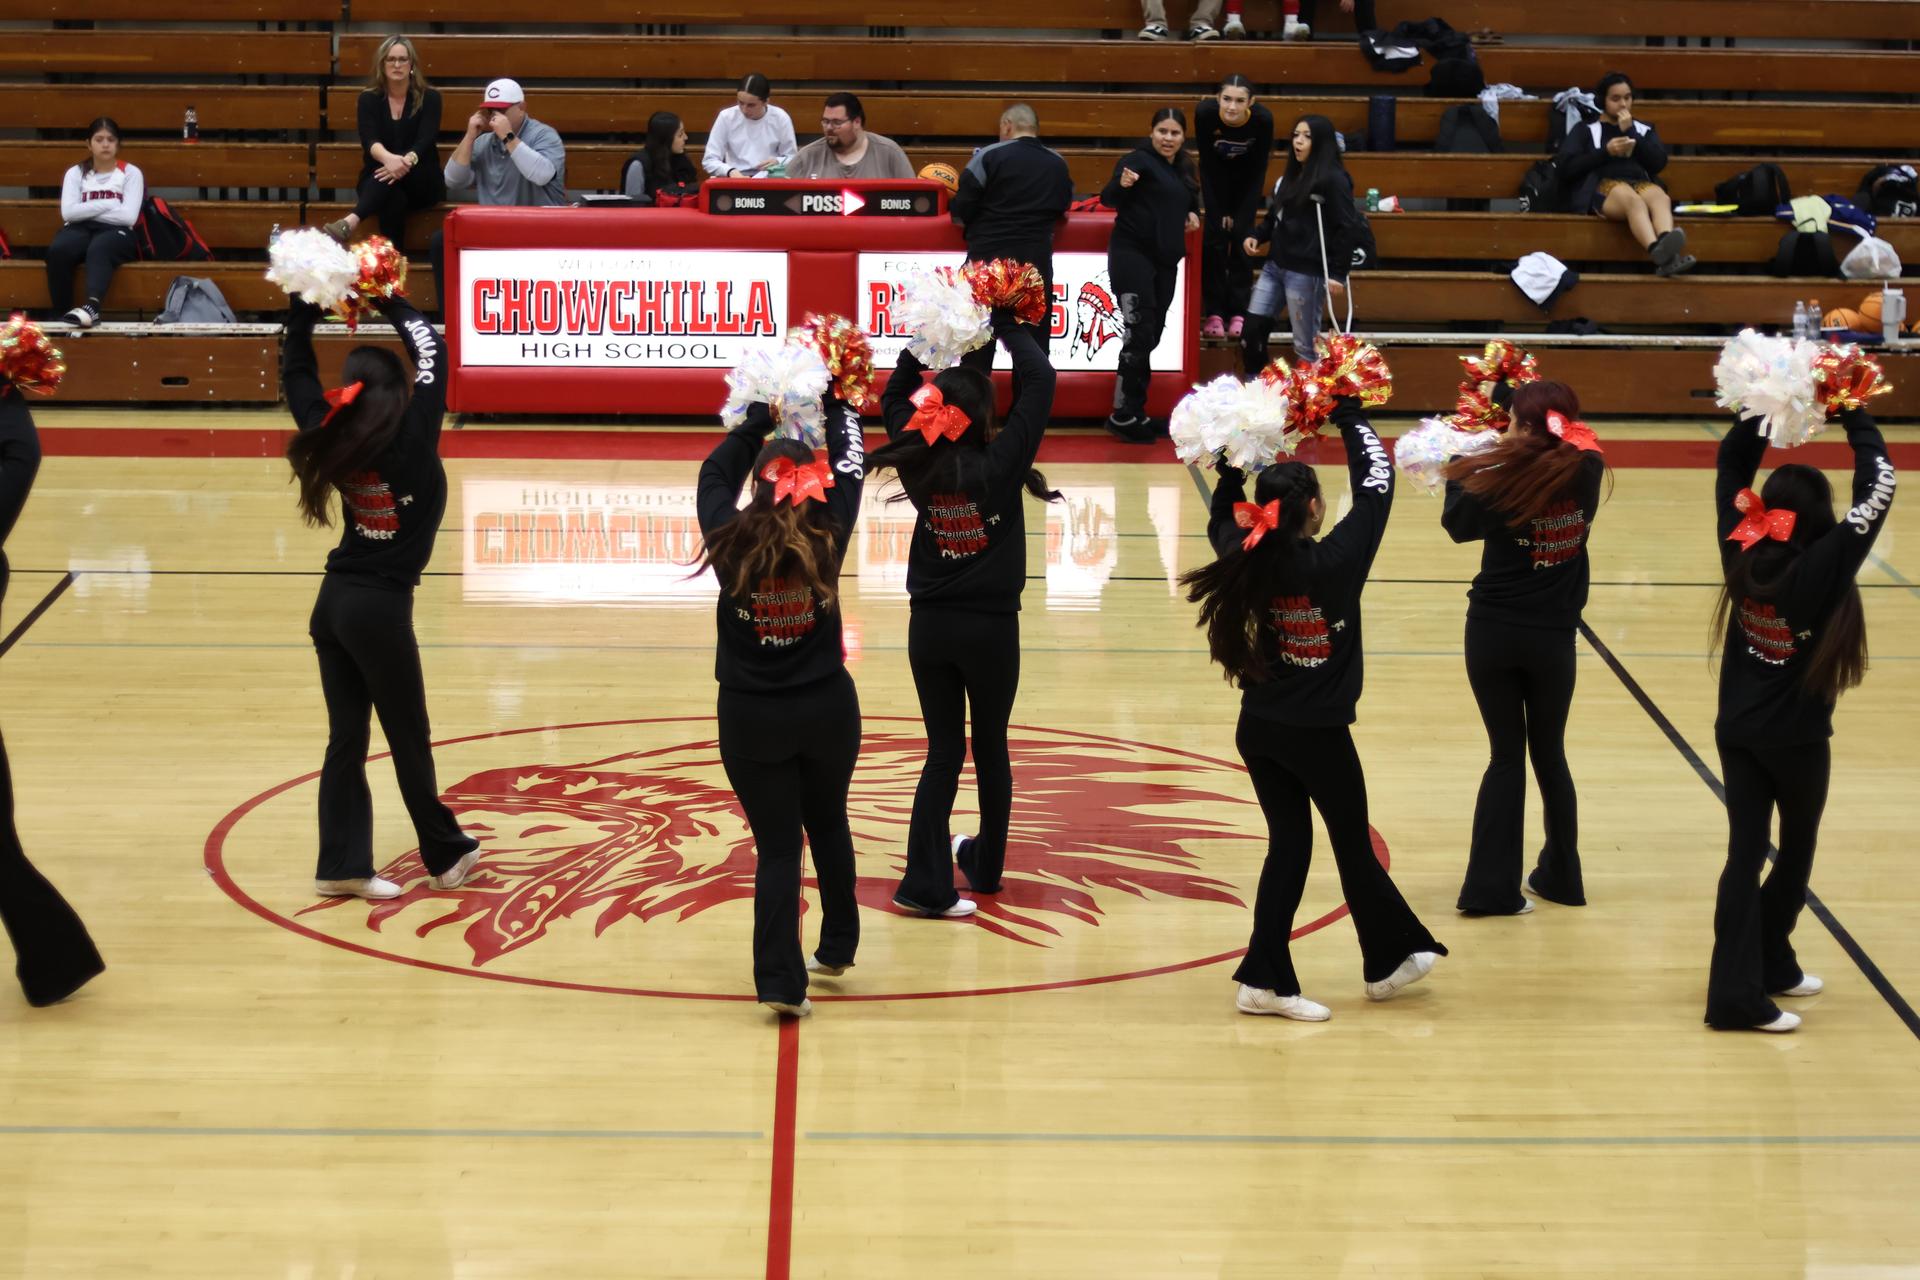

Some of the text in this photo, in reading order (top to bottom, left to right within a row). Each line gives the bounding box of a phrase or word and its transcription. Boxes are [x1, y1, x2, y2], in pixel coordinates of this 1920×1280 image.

[487, 87, 500, 98] C
[735, 198, 765, 209] BONUS
[802, 195, 843, 213] POSS
[881, 199, 911, 210] BONUS
[472, 278, 777, 336] CHOWCHILLA
[404, 320, 437, 384] Senior
[521, 342, 728, 359] HIGH SCHOOL
[836, 406, 864, 480] Senior
[1355, 424, 1390, 493] Senior
[1846, 456, 1896, 534] Senior
[1280, 651, 1329, 668] Cheer
